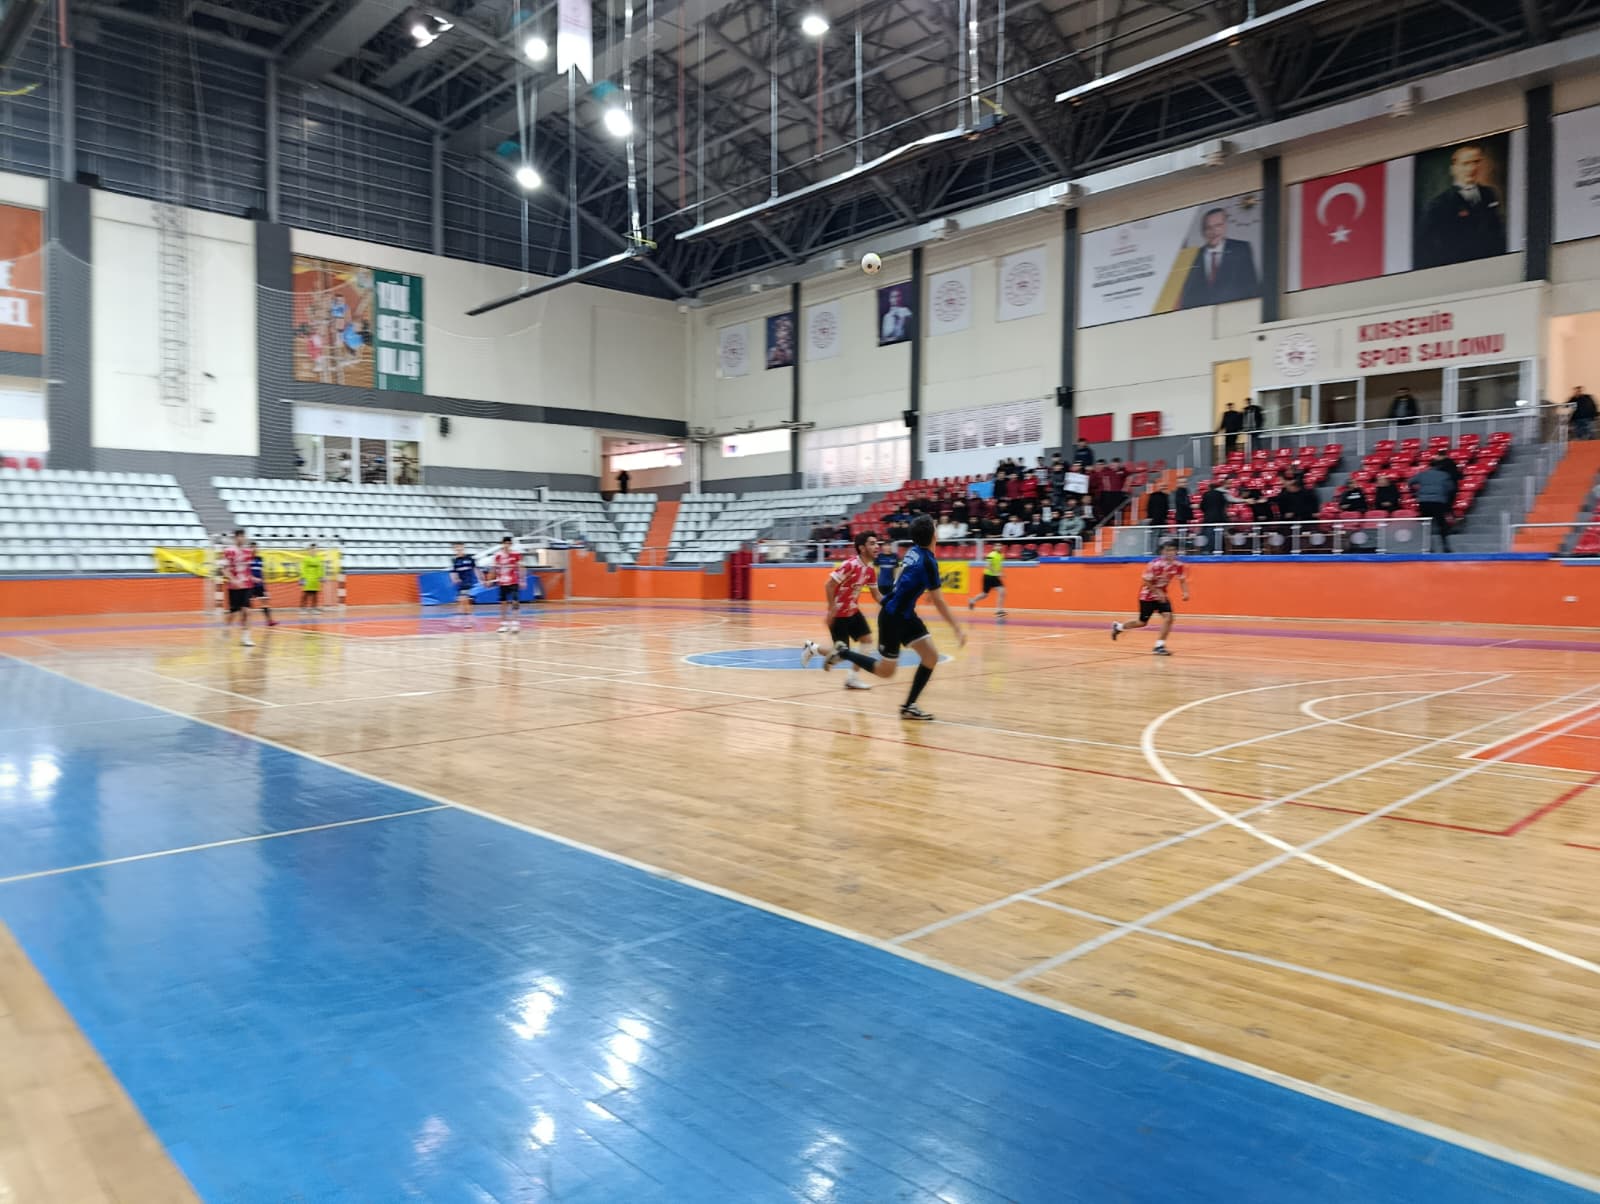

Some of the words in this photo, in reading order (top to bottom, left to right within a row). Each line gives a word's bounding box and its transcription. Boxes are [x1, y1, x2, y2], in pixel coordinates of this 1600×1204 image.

[1357, 311, 1453, 342] KIRŞEHİR
[1357, 346, 1410, 368] SPOR
[1418, 334, 1504, 361] SALONU
